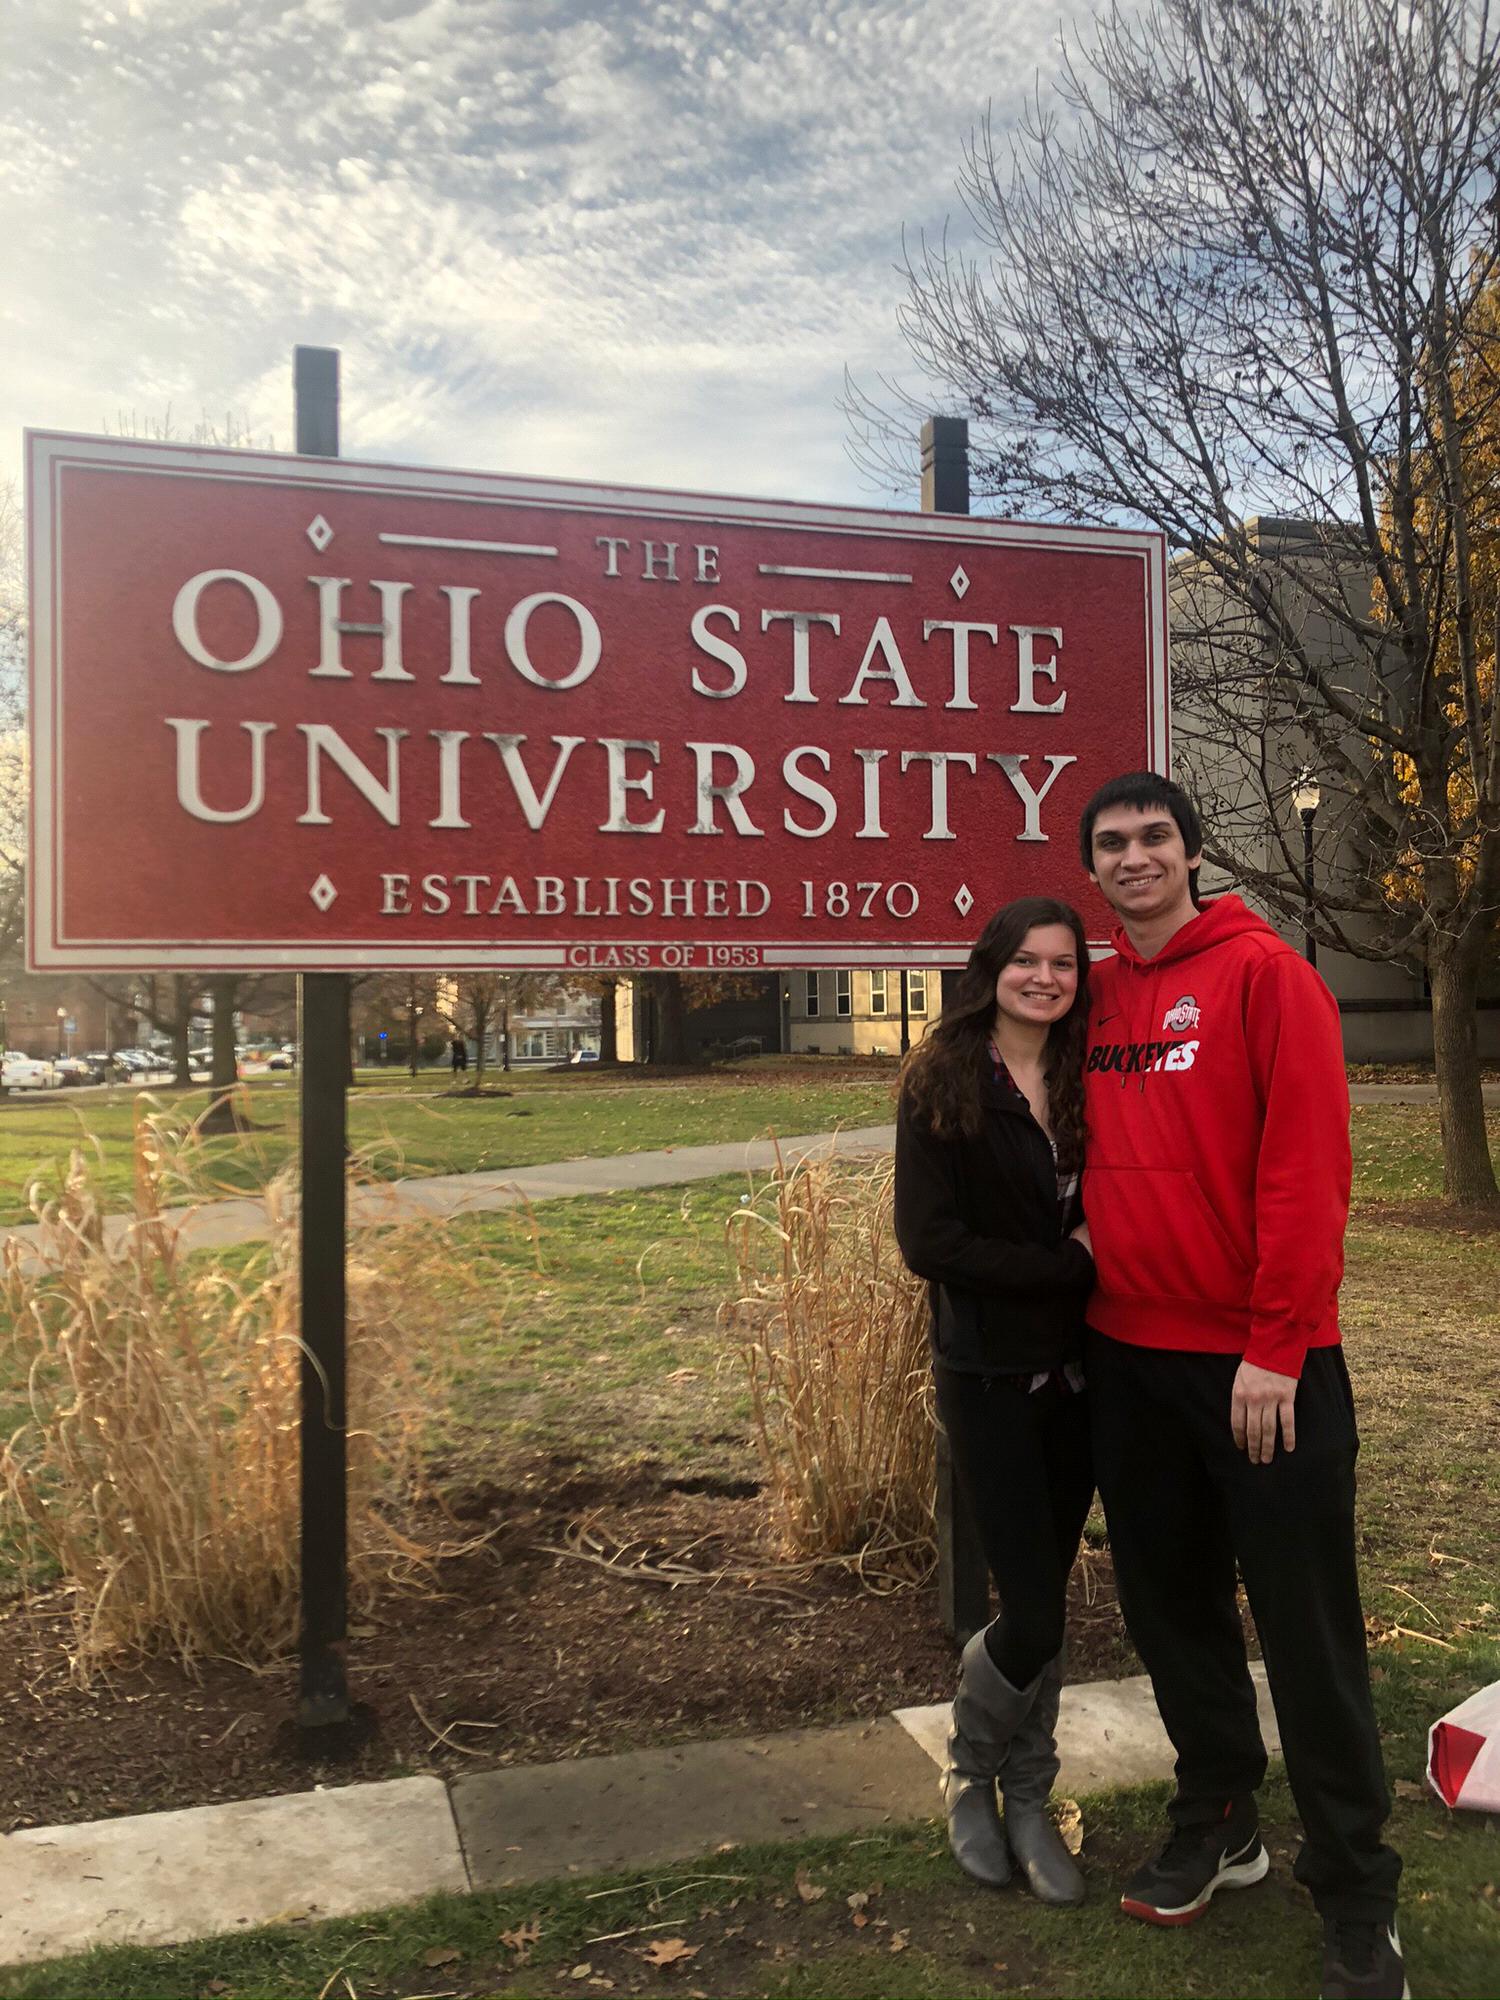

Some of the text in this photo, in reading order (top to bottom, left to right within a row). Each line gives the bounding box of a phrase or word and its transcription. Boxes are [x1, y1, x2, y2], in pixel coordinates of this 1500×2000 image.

[596, 536, 721, 584] THE
[171, 568, 1068, 714] OHIO STATE
[164, 717, 1078, 842] UNIVERSITY
[380, 873, 921, 919] ESTABLISHED 1870
[568, 946, 760, 967] CLASS OF 1953
[1162, 1003, 1201, 1030] OHIO STATE
[1088, 1040, 1200, 1073] BUCKEYES
